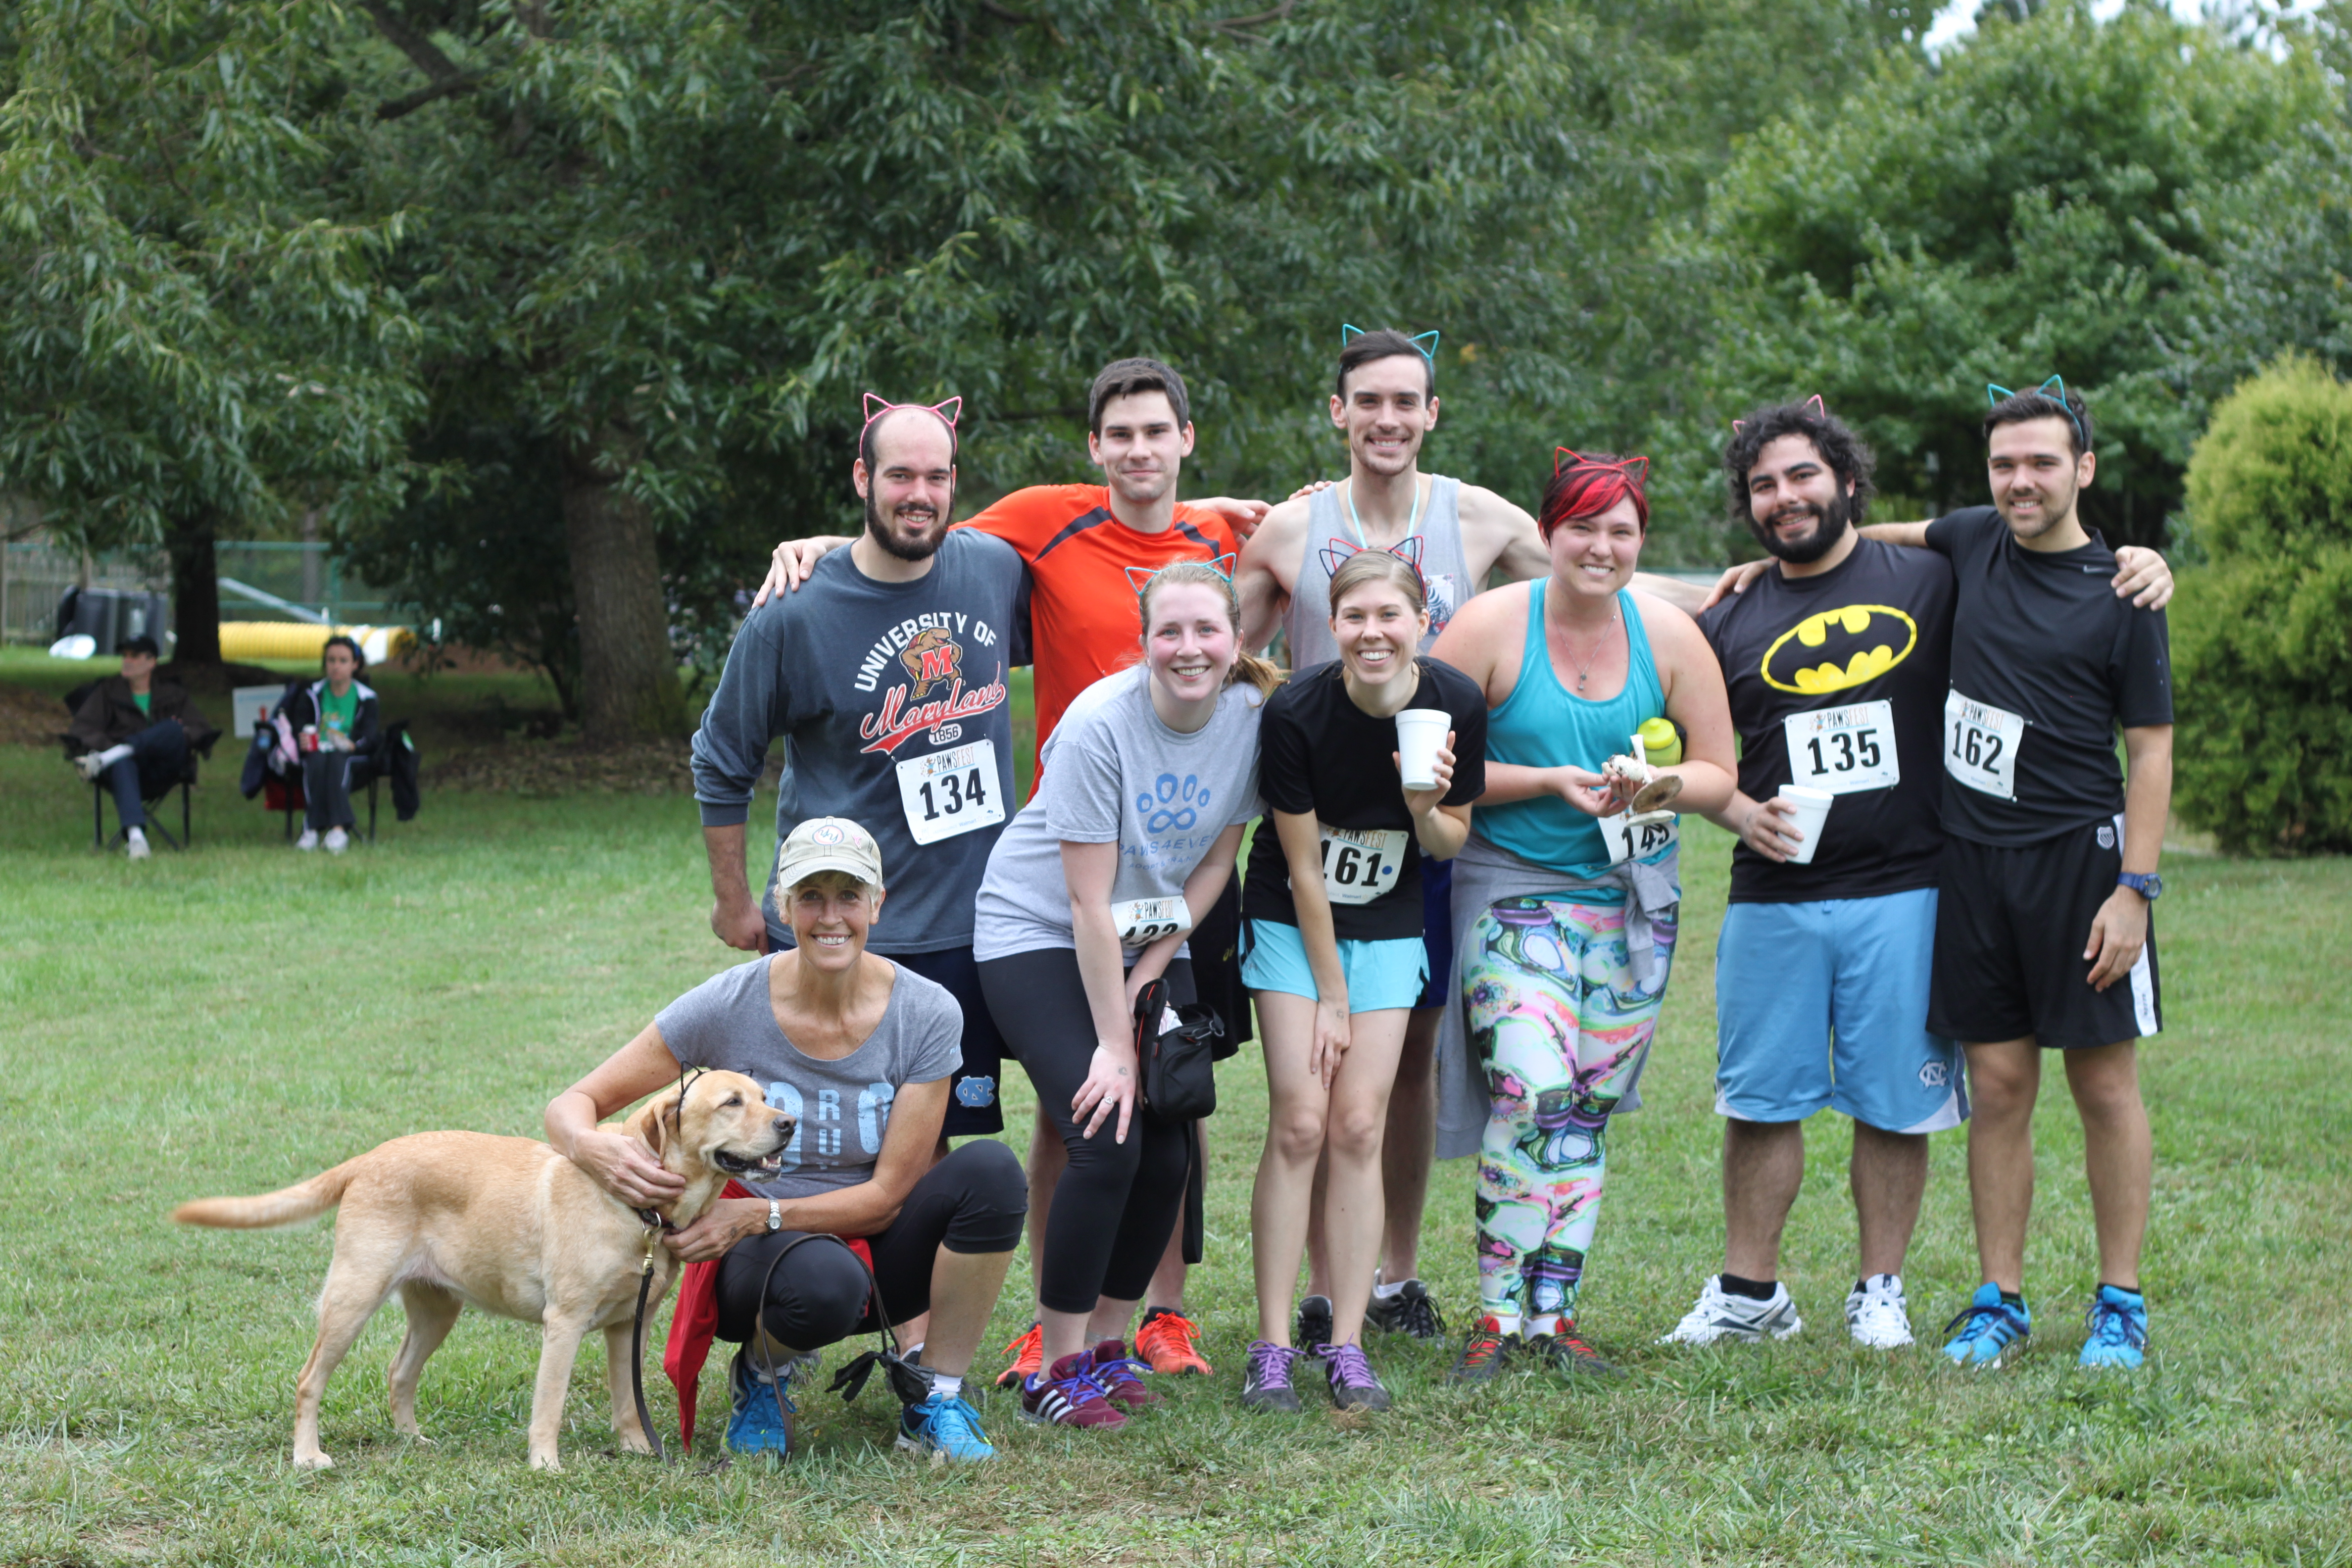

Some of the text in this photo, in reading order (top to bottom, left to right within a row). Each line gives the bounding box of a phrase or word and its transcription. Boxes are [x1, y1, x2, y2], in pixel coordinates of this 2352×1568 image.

[854, 612, 996, 692] UNIVERSITY OF
[921, 644, 953, 681] M
[860, 660, 1006, 742] Maryland
[1970, 703, 2004, 731] PAWSFEST
[1827, 706, 1869, 729] PAWSFEST
[933, 726, 959, 743] 1856
[1953, 720, 2003, 775] 162
[936, 746, 975, 773] PAWSFEST
[1808, 728, 1881, 776] 135
[919, 767, 986, 821] 134
[1119, 835, 1213, 856] PAWS4EVE
[1144, 900, 1174, 919] PAWSFEST
